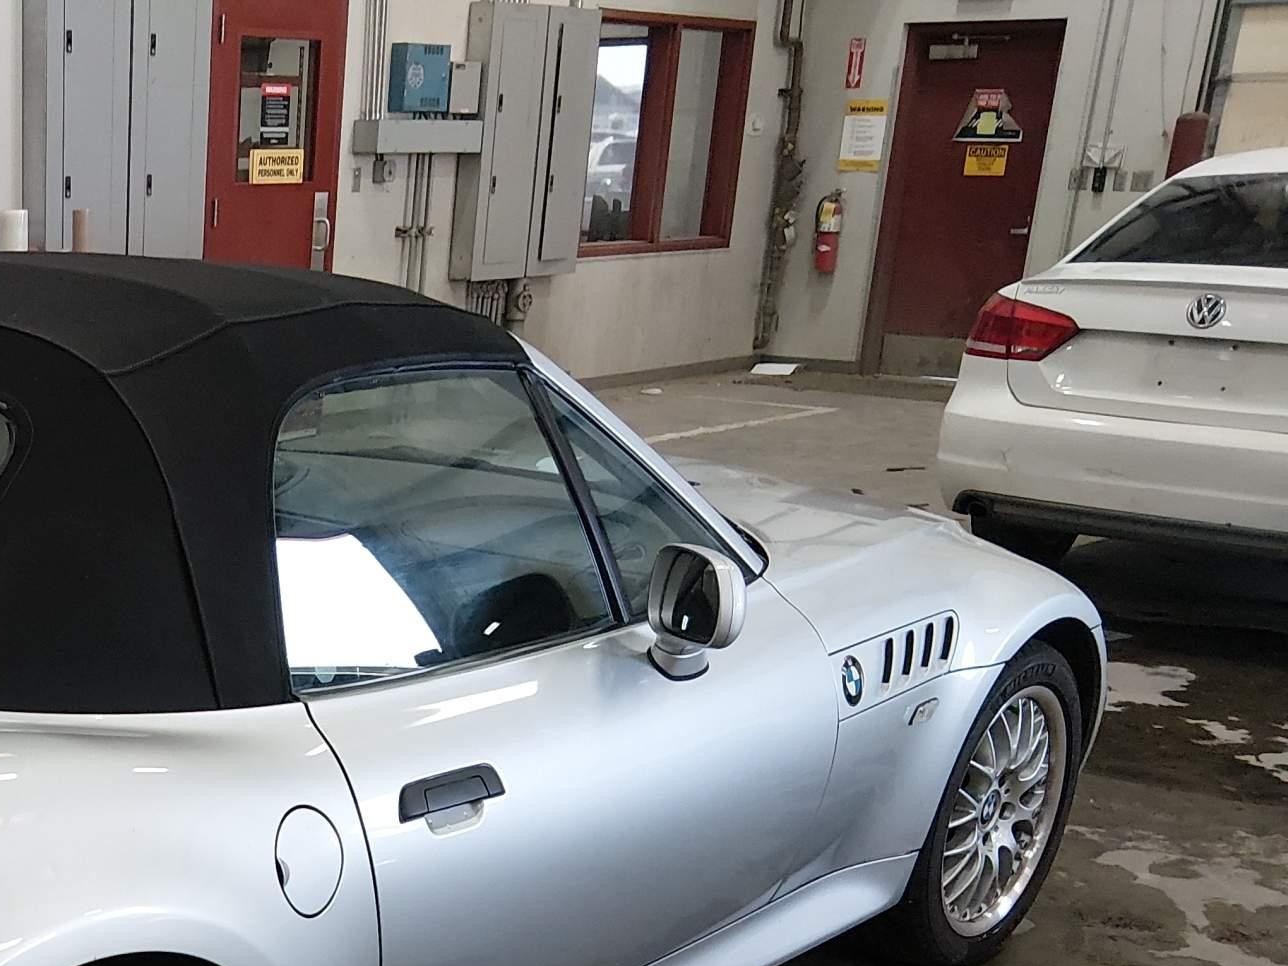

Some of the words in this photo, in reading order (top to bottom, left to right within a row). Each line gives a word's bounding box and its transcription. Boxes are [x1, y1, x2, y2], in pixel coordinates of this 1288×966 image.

[969, 147, 1005, 157] CAUTION
[258, 155, 300, 167] AUTHORIZED
[258, 168, 285, 177] PERSONNEL
[286, 167, 299, 177] ONLY
